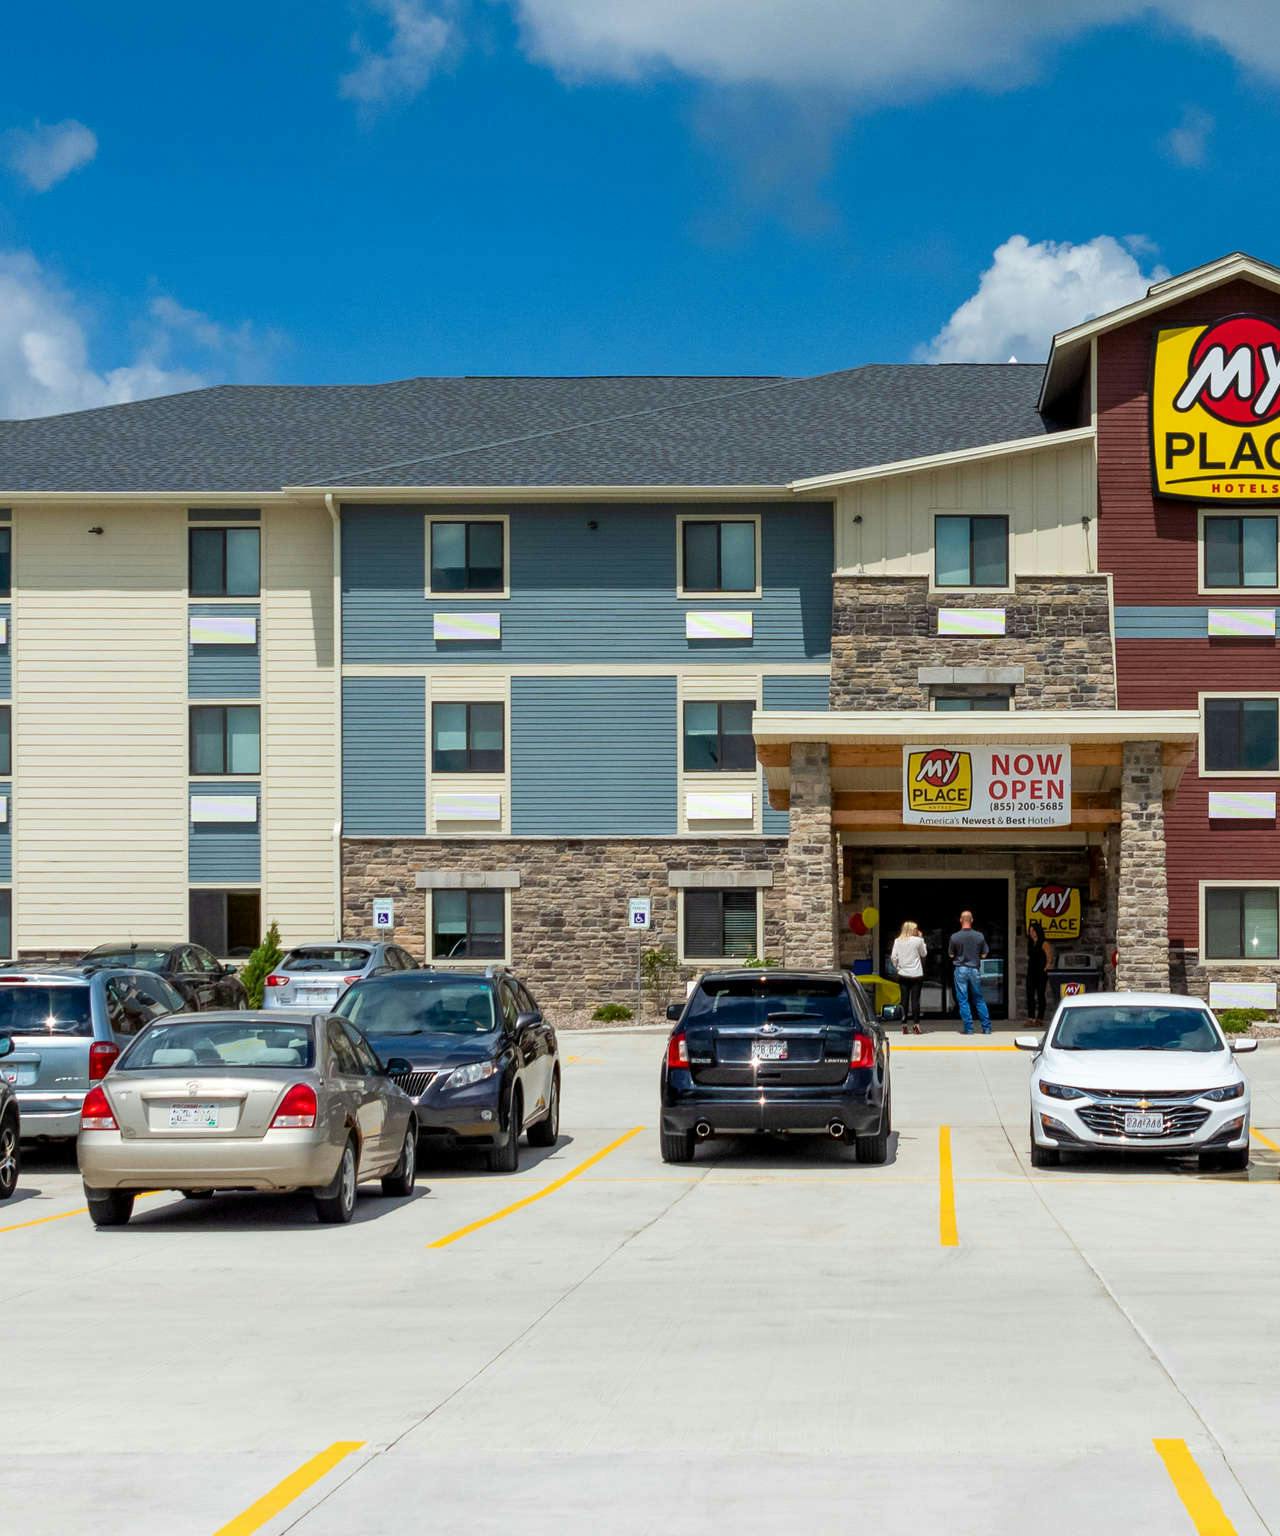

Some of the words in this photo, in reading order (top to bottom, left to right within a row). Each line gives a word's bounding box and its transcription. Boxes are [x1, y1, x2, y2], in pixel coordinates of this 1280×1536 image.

[1211, 483, 1280, 494] HOTELS
[991, 753, 1063, 776] NOW
[912, 788, 968, 802] PLACE
[988, 779, 1064, 800] OPEN
[989, 801, 1015, 812] (855)
[1017, 801, 1064, 812] 200-5685
[961, 816, 996, 825] Newest
[997, 816, 1004, 825] &
[1005, 816, 1026, 825] Best
[1027, 816, 1056, 825] Hotels
[1029, 918, 1078, 930] PLACE
